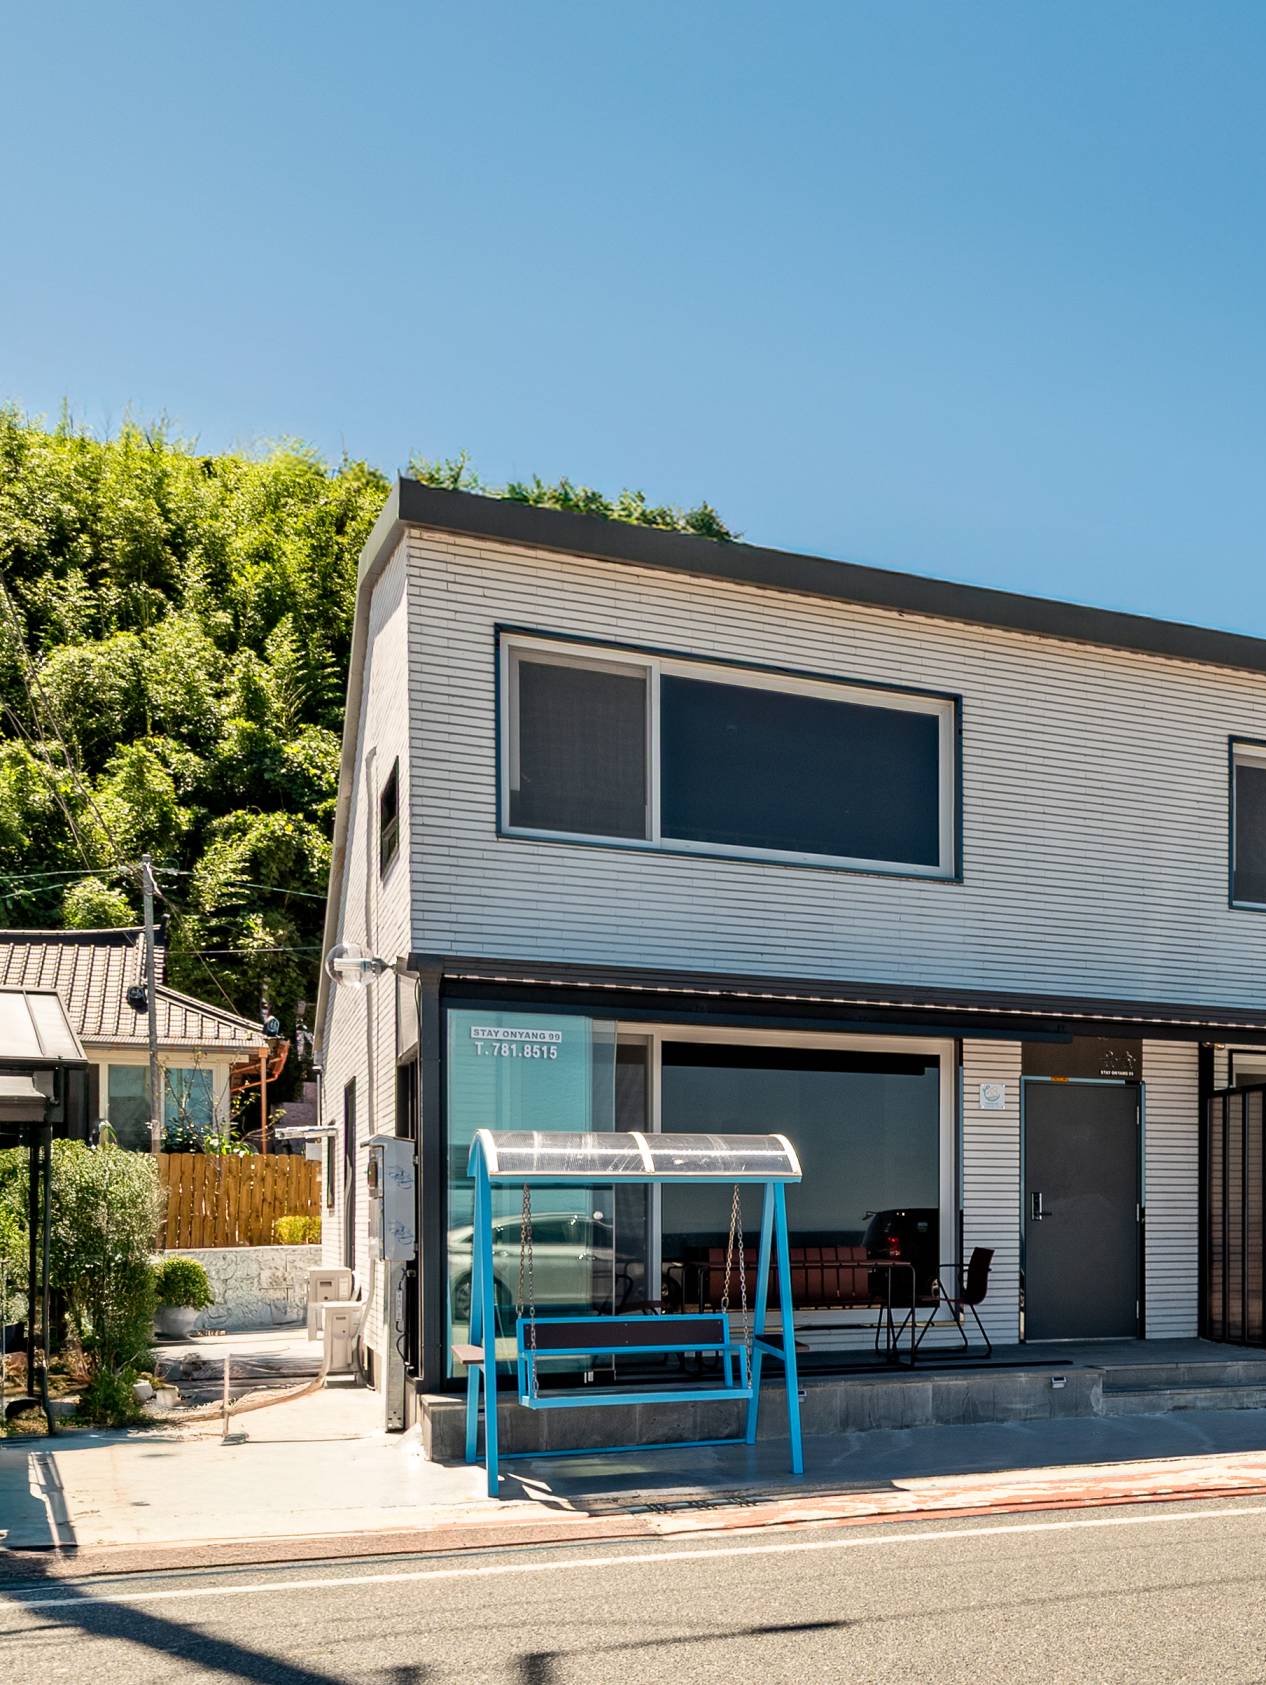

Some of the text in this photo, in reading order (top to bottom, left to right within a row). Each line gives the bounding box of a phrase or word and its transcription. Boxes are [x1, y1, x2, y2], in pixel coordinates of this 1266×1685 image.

[473, 1028, 561, 1041] STAY ONYANG 99
